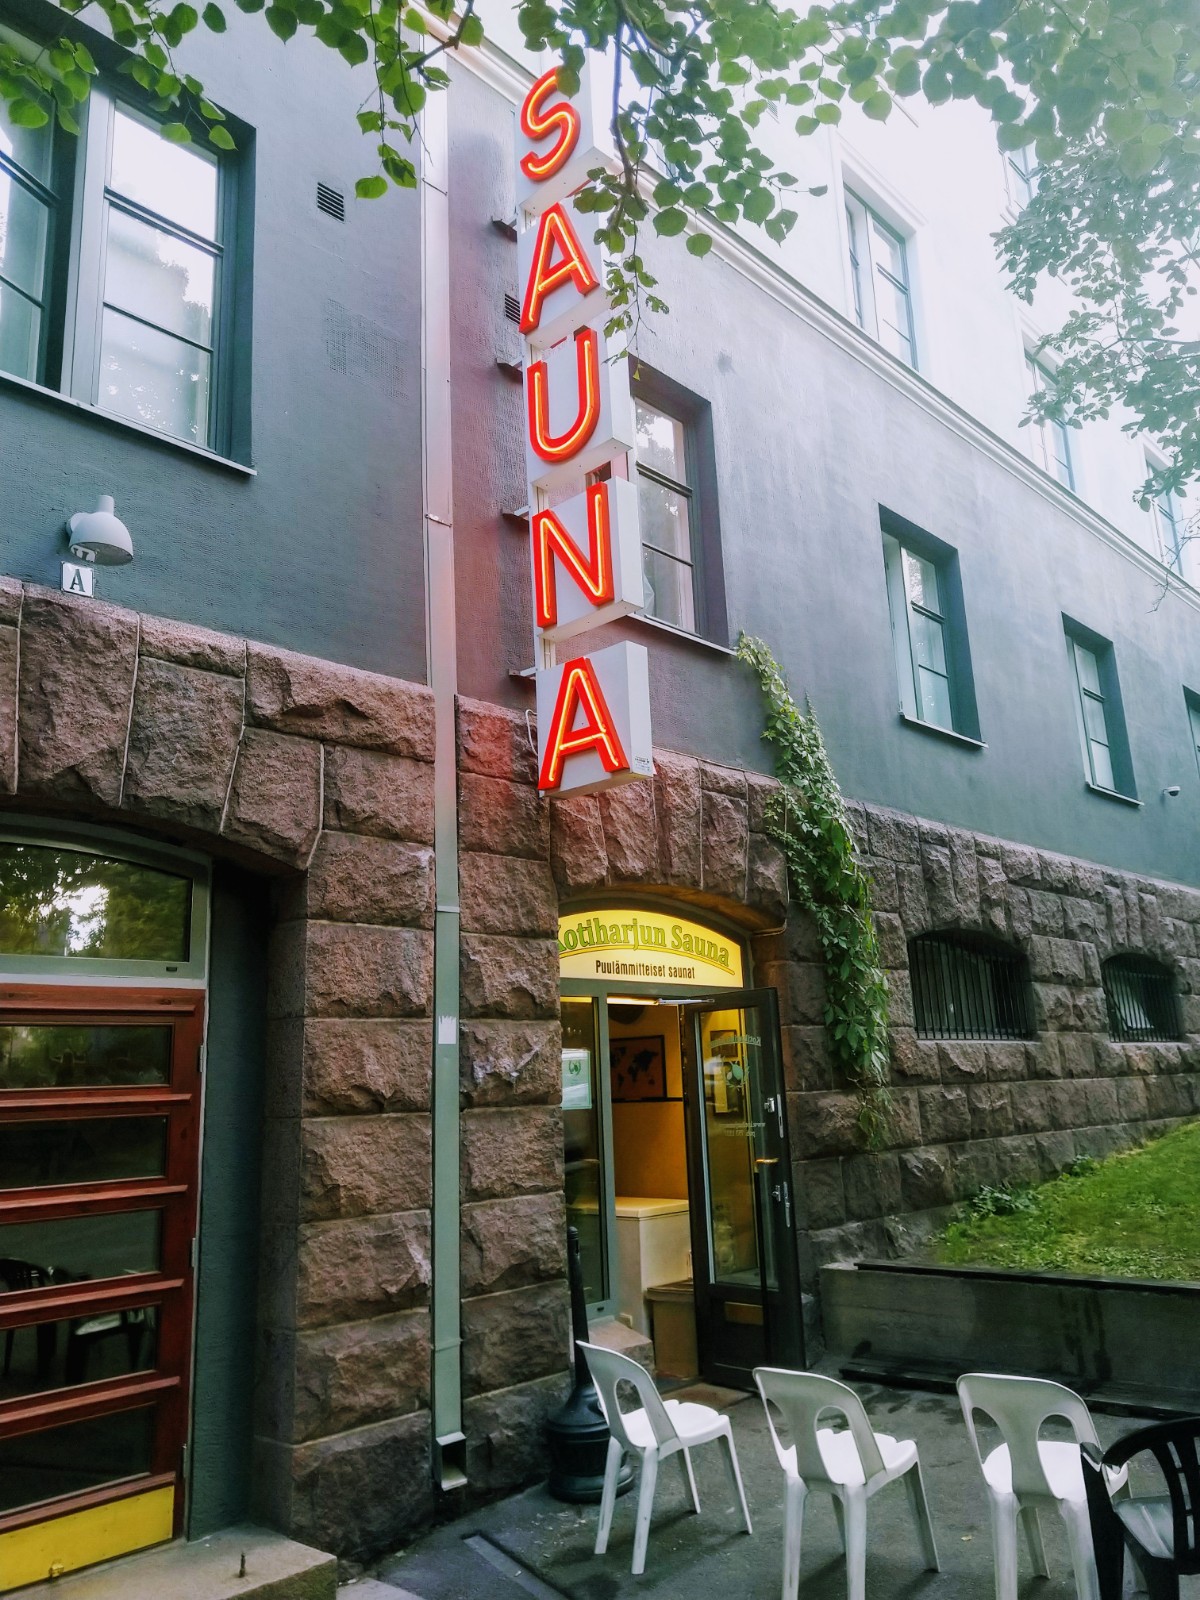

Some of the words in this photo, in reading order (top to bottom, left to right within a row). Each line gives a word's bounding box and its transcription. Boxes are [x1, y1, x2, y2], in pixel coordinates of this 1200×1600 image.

[519, 65, 629, 791] SAUNA
[70, 568, 86, 593] A
[671, 925, 729, 968] Sauna
[595, 960, 666, 978] Puulämmitteiset
[668, 966, 695, 979] saunat
